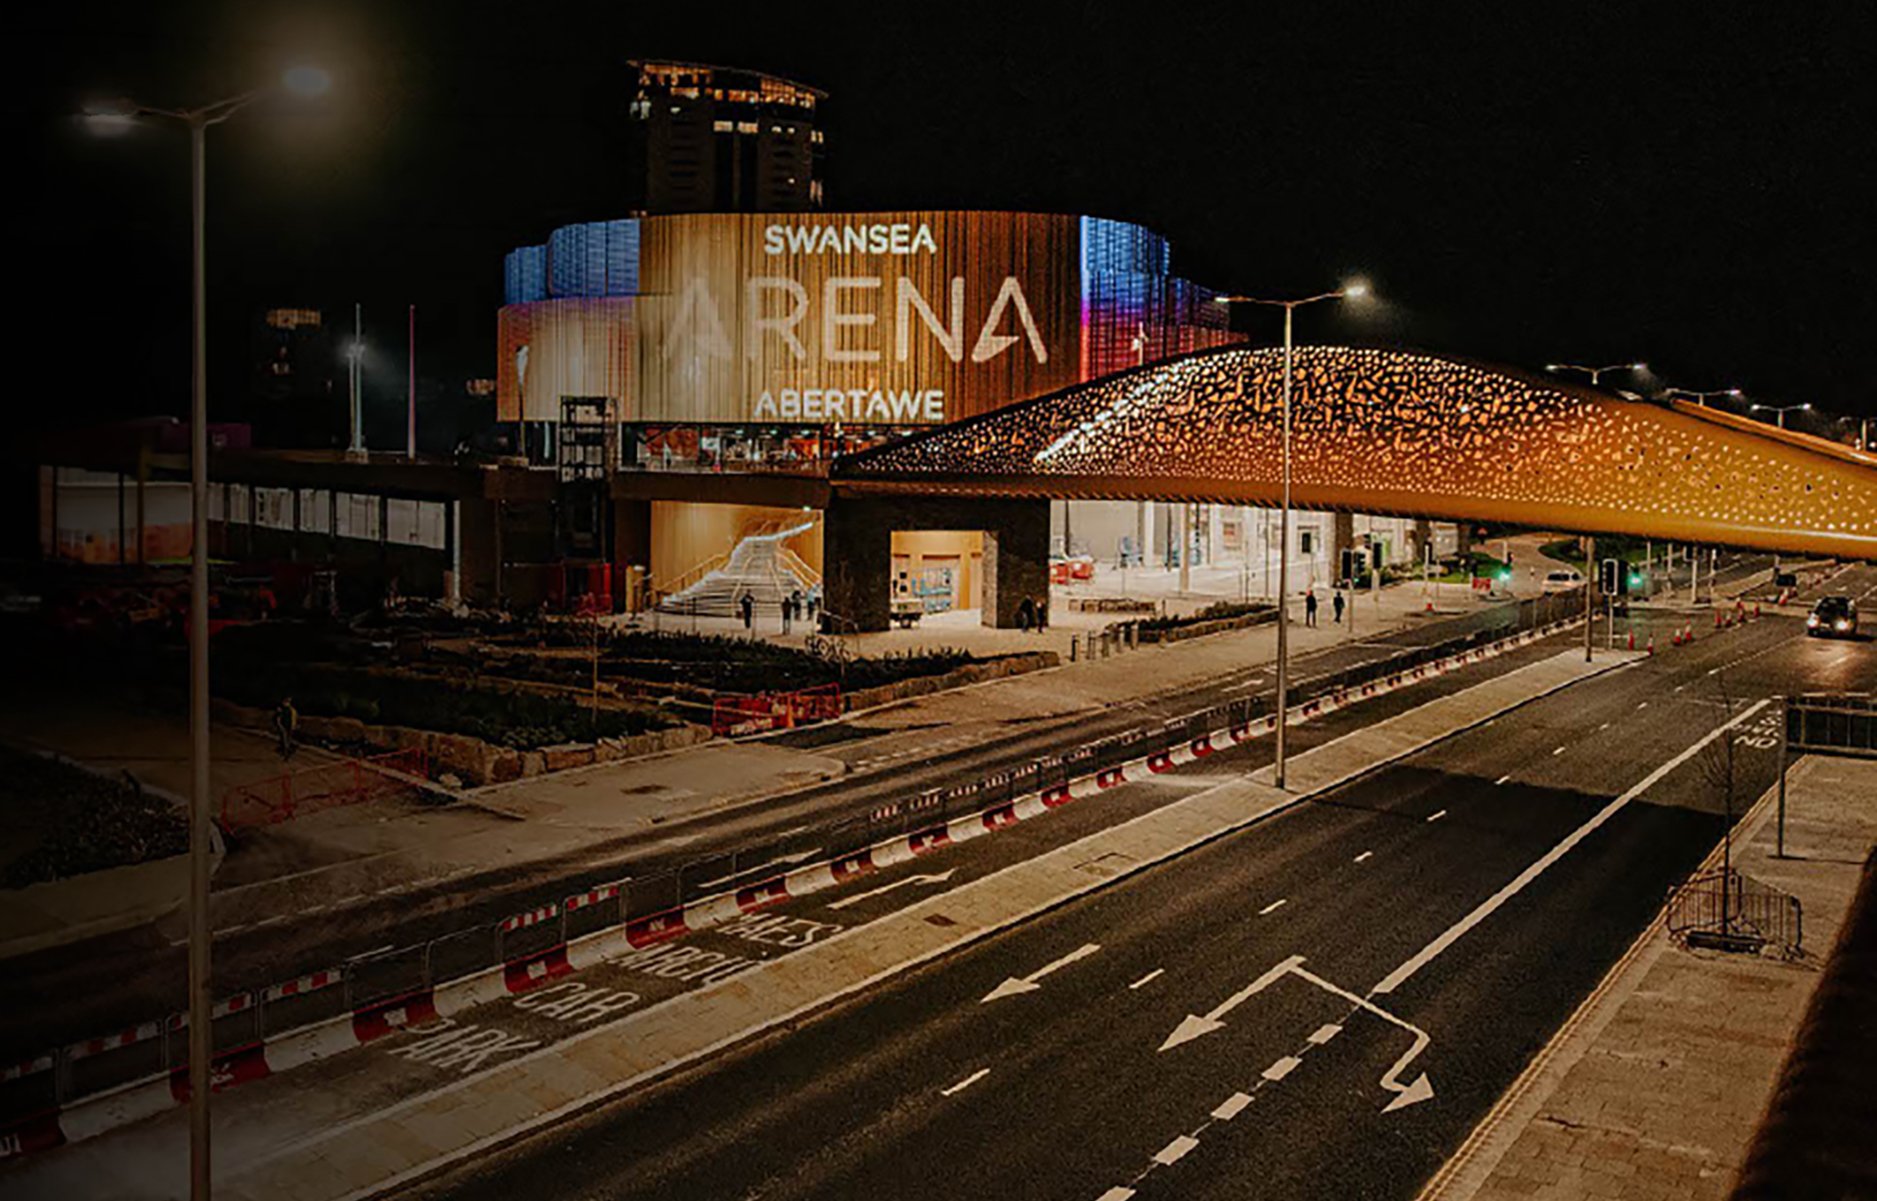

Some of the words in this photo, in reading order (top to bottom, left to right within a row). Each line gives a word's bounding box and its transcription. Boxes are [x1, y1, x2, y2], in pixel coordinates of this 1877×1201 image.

[764, 223, 937, 255] SWANSEA
[664, 275, 1049, 364] ARENA
[753, 388, 944, 420] ABERTAWE
[606, 942, 762, 984] ARCI
[513, 982, 640, 1023] CAR
